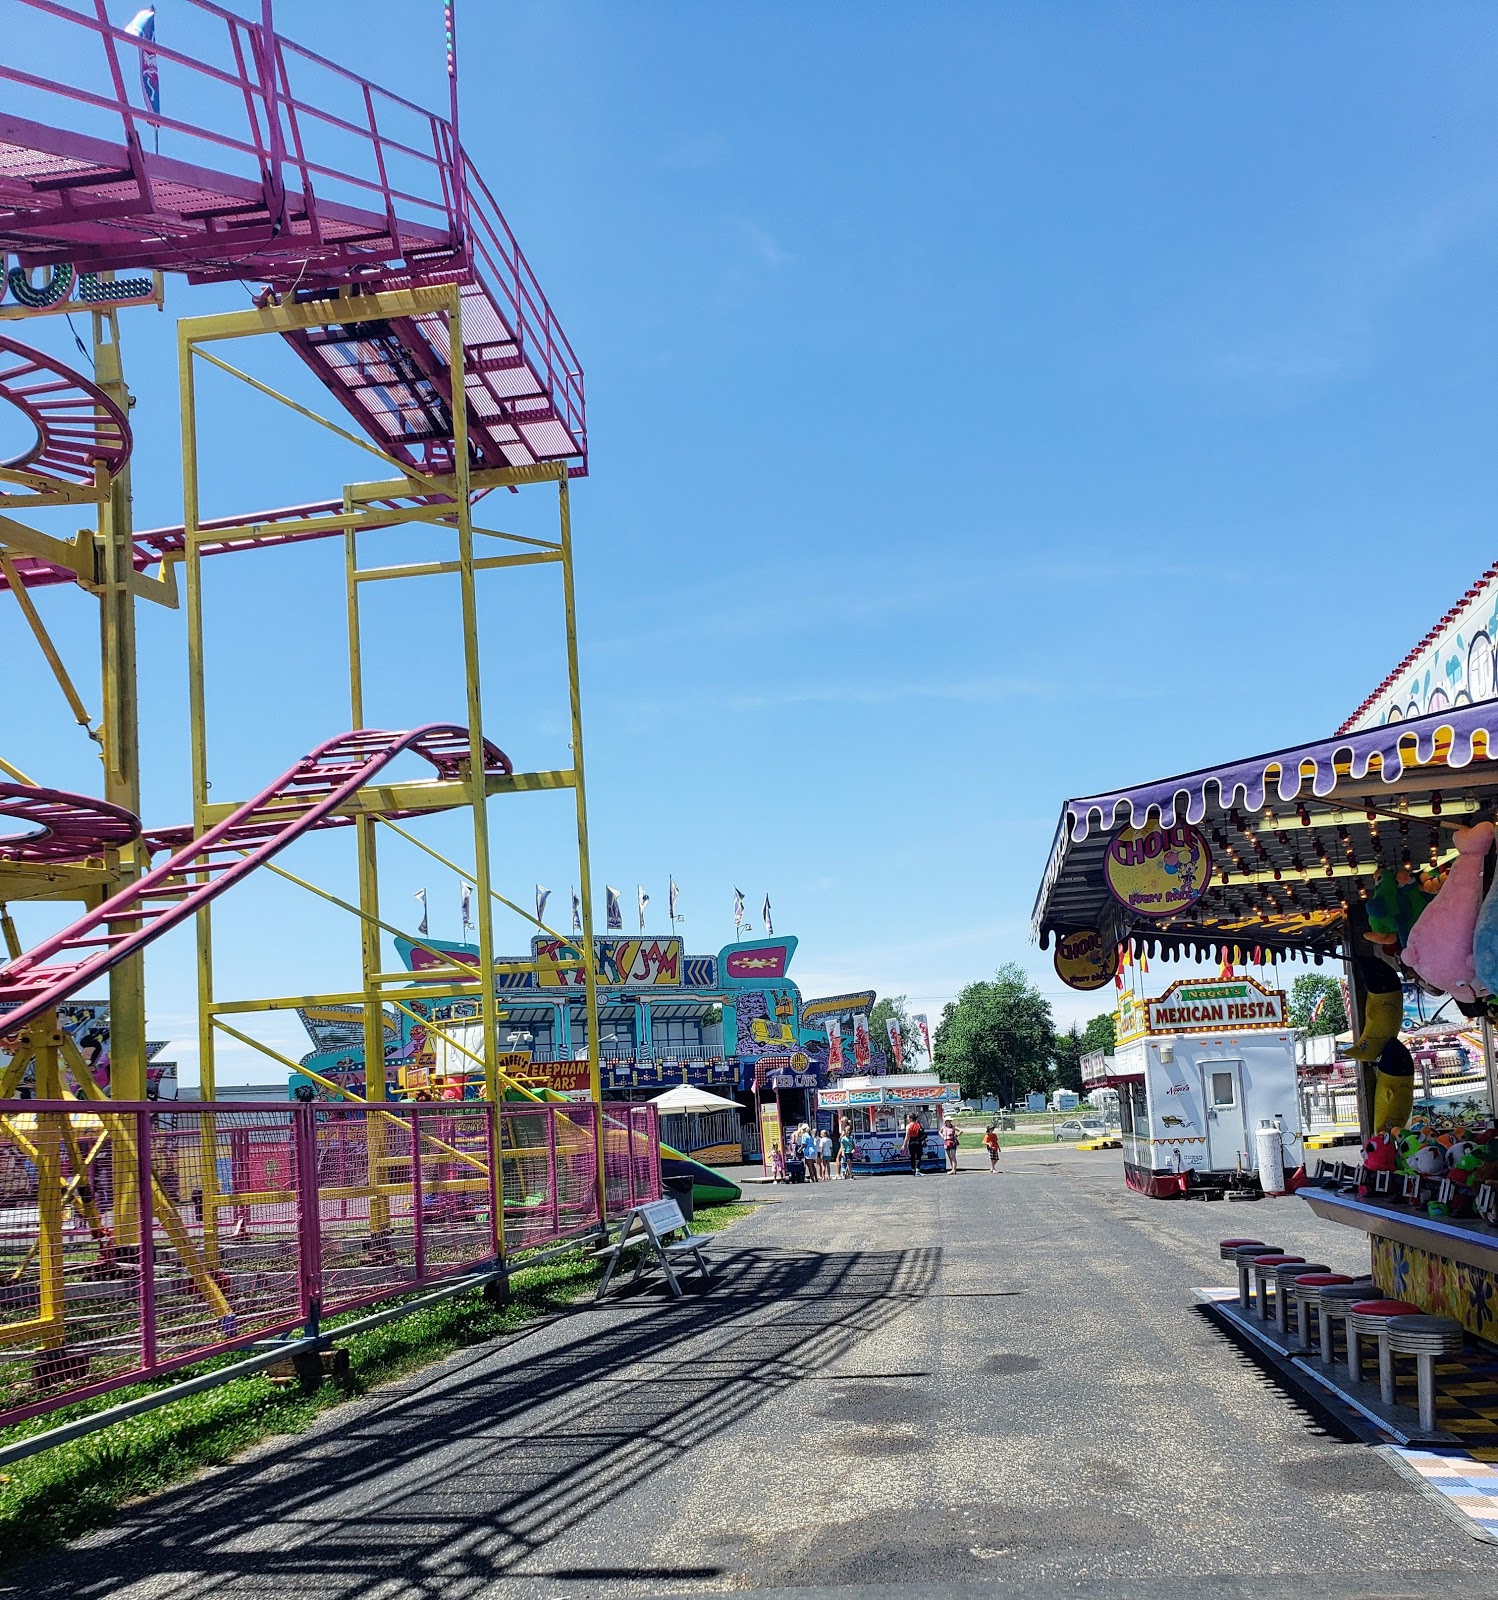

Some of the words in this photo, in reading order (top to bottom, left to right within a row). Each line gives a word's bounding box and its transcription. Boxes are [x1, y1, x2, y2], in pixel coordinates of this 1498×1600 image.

[1111, 823, 1199, 866] CHOICE
[632, 940, 678, 980] JAM
[1188, 987, 1241, 999] Nagel's
[1156, 1005, 1224, 1024] MEXICAN
[1227, 1002, 1277, 1020] FIESTA
[499, 1054, 528, 1069] NAGEL'S
[547, 1076, 576, 1090] EARS
[795, 1074, 817, 1088] CARS
